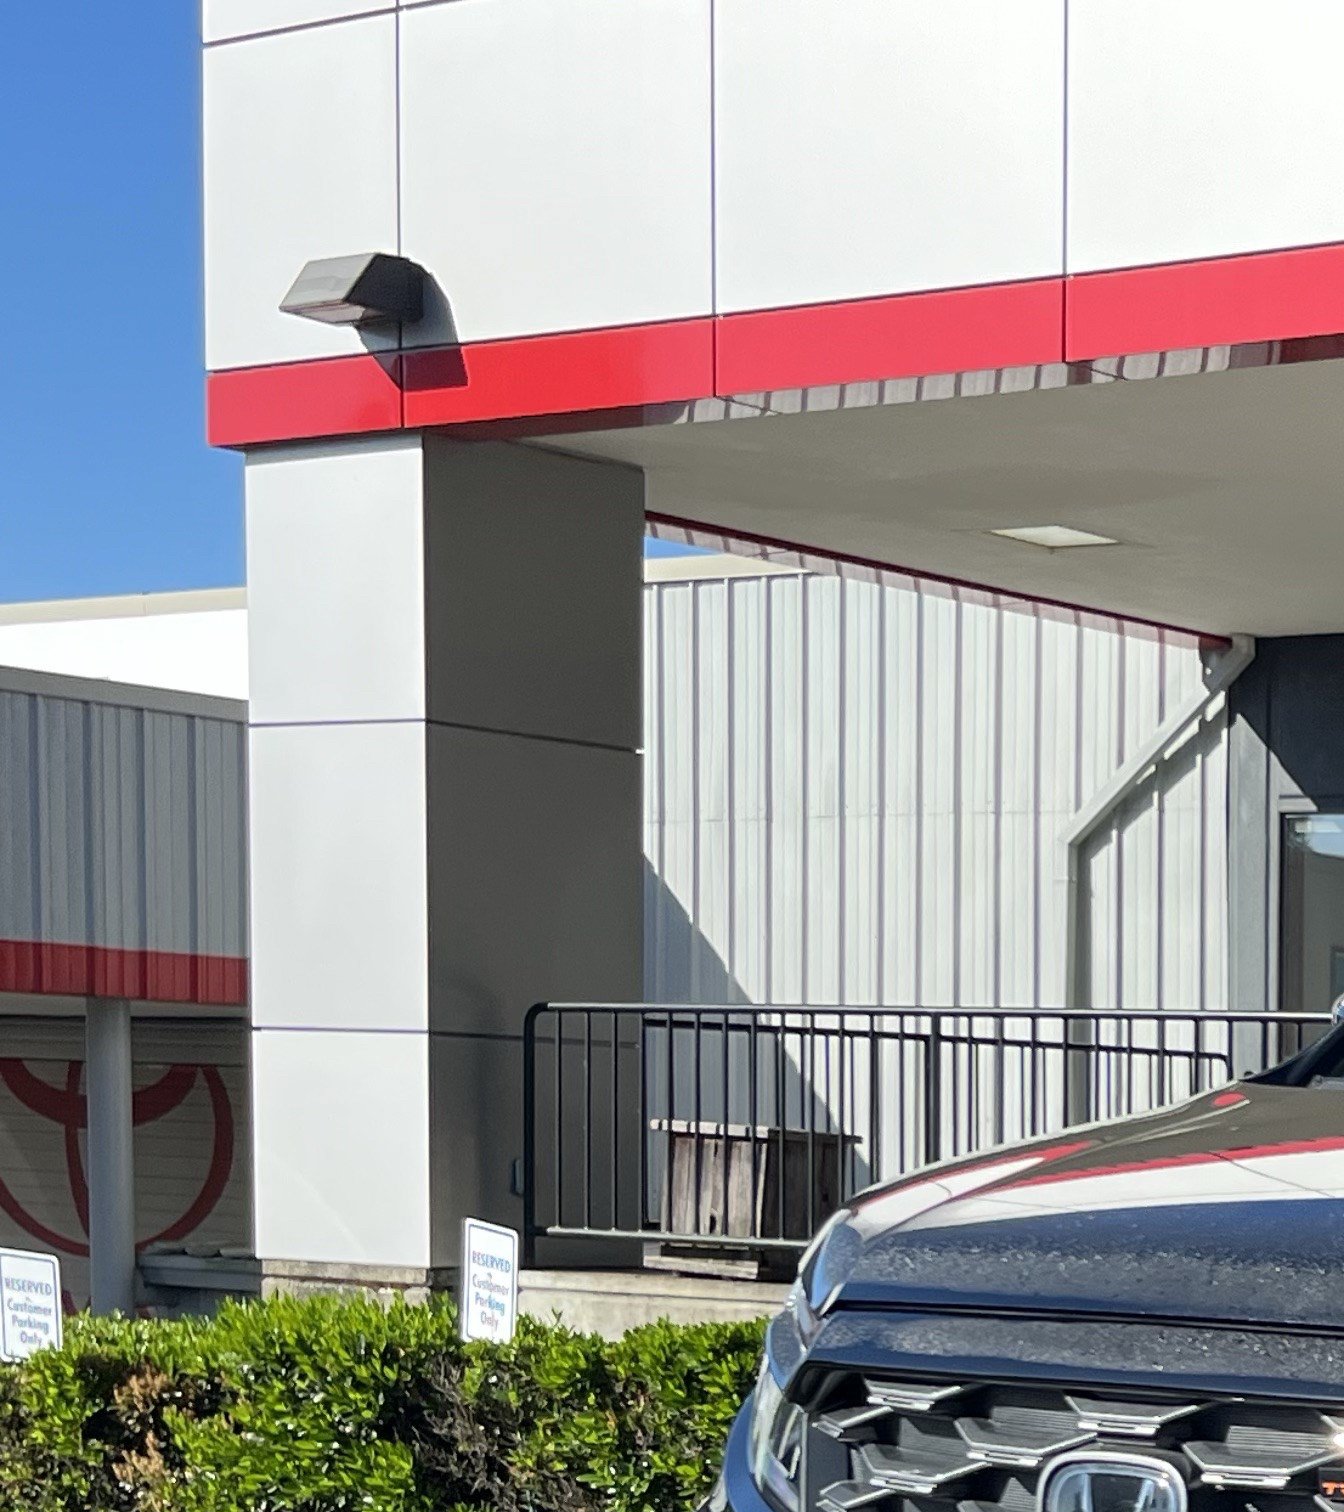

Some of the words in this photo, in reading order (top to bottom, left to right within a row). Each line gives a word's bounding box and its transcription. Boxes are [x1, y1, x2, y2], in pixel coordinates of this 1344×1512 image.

[472, 1250, 511, 1273] RESERVED
[4, 1277, 52, 1296] RESERVED
[472, 1273, 510, 1295] Customer
[7, 1297, 52, 1316] Customer
[475, 1291, 505, 1317] Parking
[12, 1314, 50, 1335] Parking
[480, 1310, 499, 1332] Only
[20, 1330, 42, 1347] Only
